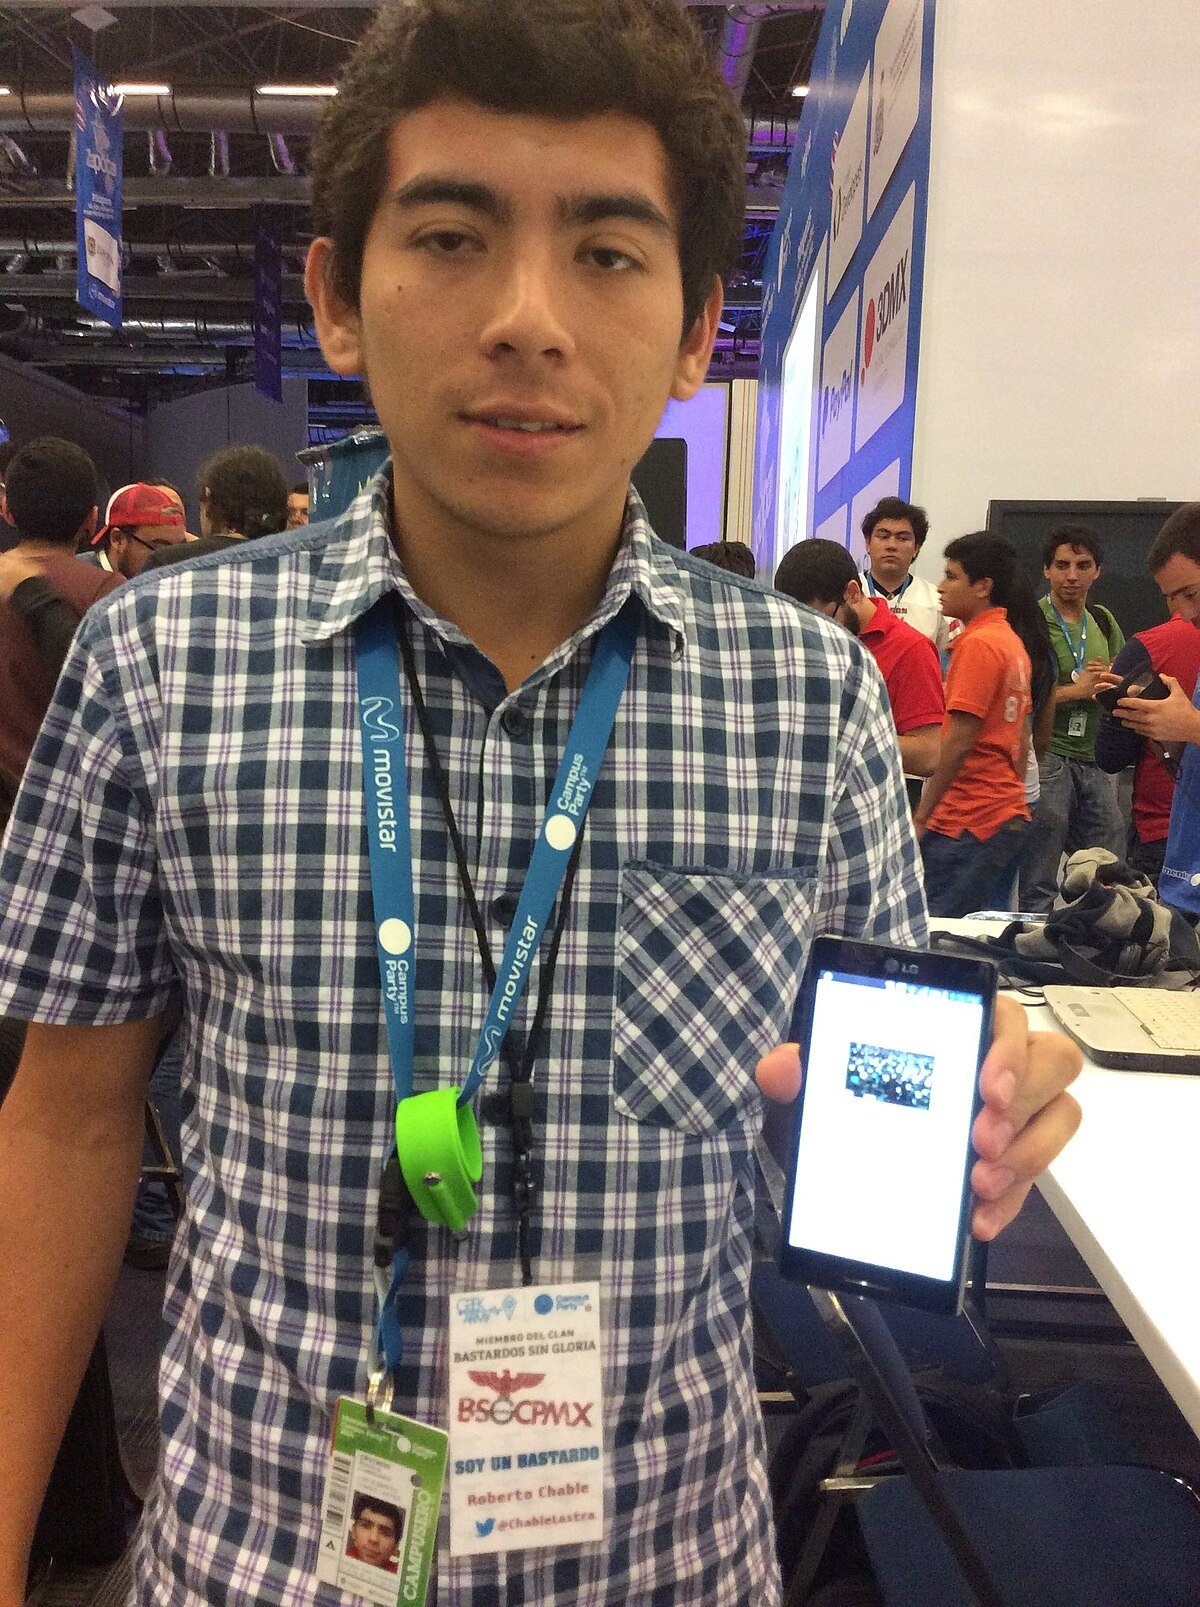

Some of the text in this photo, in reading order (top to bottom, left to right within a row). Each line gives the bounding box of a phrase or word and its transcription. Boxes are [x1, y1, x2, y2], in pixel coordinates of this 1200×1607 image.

[875, 249, 909, 342] 3DMX
[829, 359, 854, 422] PayPal
[373, 749, 397, 853] movistar
[556, 753, 584, 810] Campus
[568, 778, 592, 816] Party
[385, 960, 398, 1002] Party
[496, 914, 539, 1021] movistar
[901, 964, 919, 974] LG
[397, 959, 409, 1025] Campus
[453, 1340, 596, 1363] BASTARDOS SIN GLORIA
[475, 1329, 575, 1345] MIEMBRO DEL CLAN
[454, 1445, 600, 1475] SOY UN BASTARDO
[467, 1481, 590, 1506] Roberto Chable
